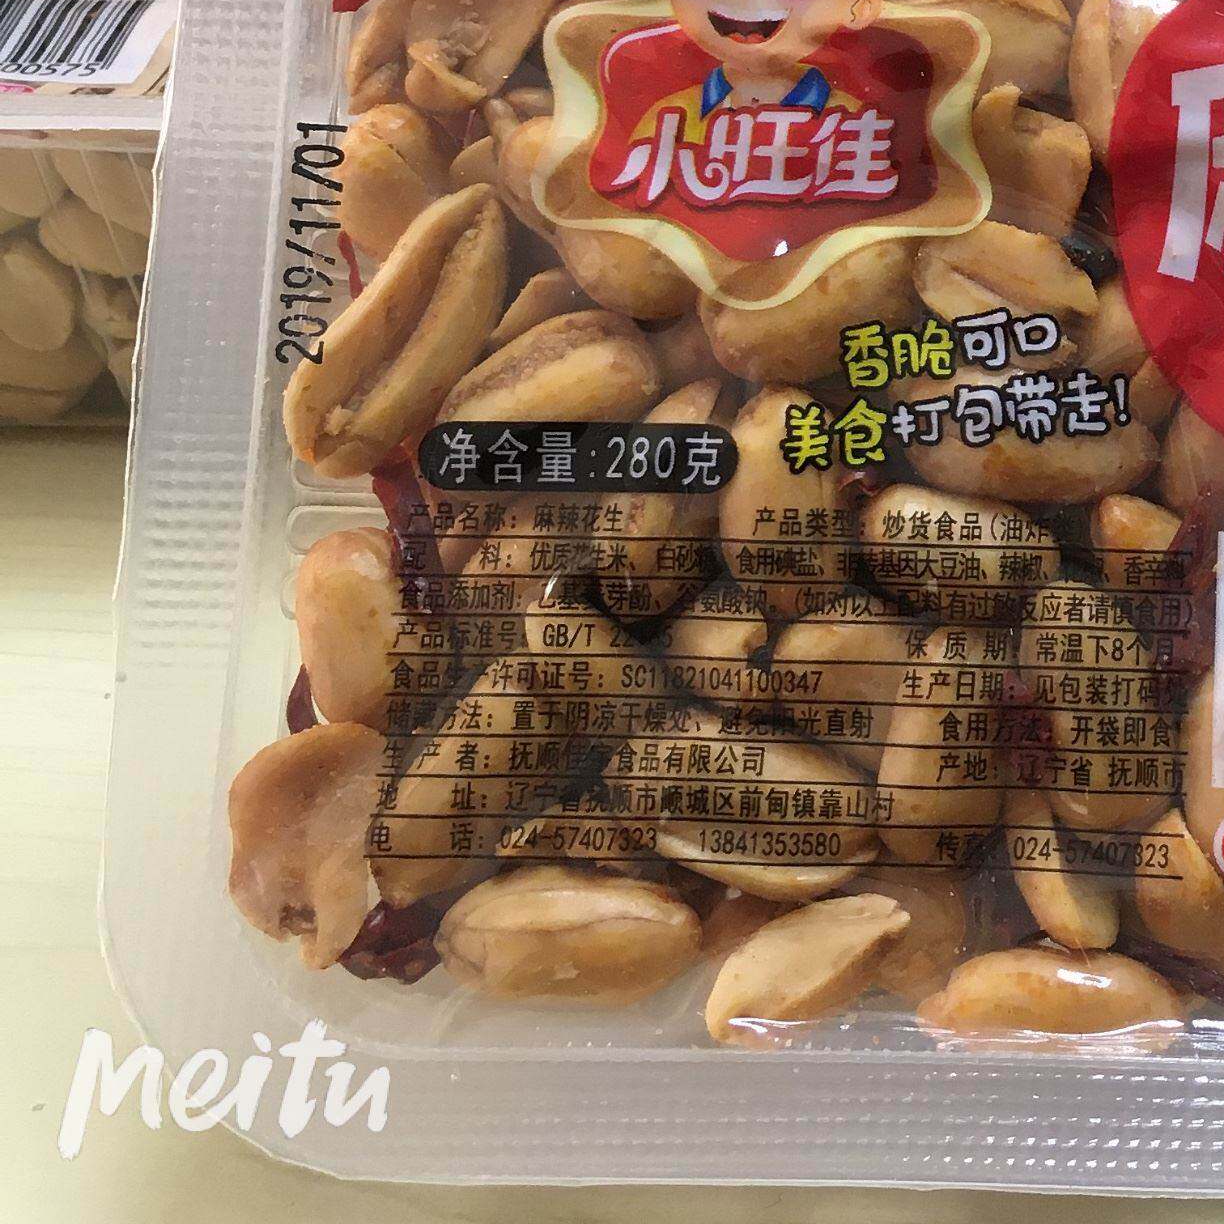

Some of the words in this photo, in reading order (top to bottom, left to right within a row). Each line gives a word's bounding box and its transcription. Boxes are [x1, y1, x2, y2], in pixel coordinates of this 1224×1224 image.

[610, 109, 902, 206] 小旺佳
[275, 121, 348, 366] 2019/11/01
[842, 309, 1060, 391] 香脆可口
